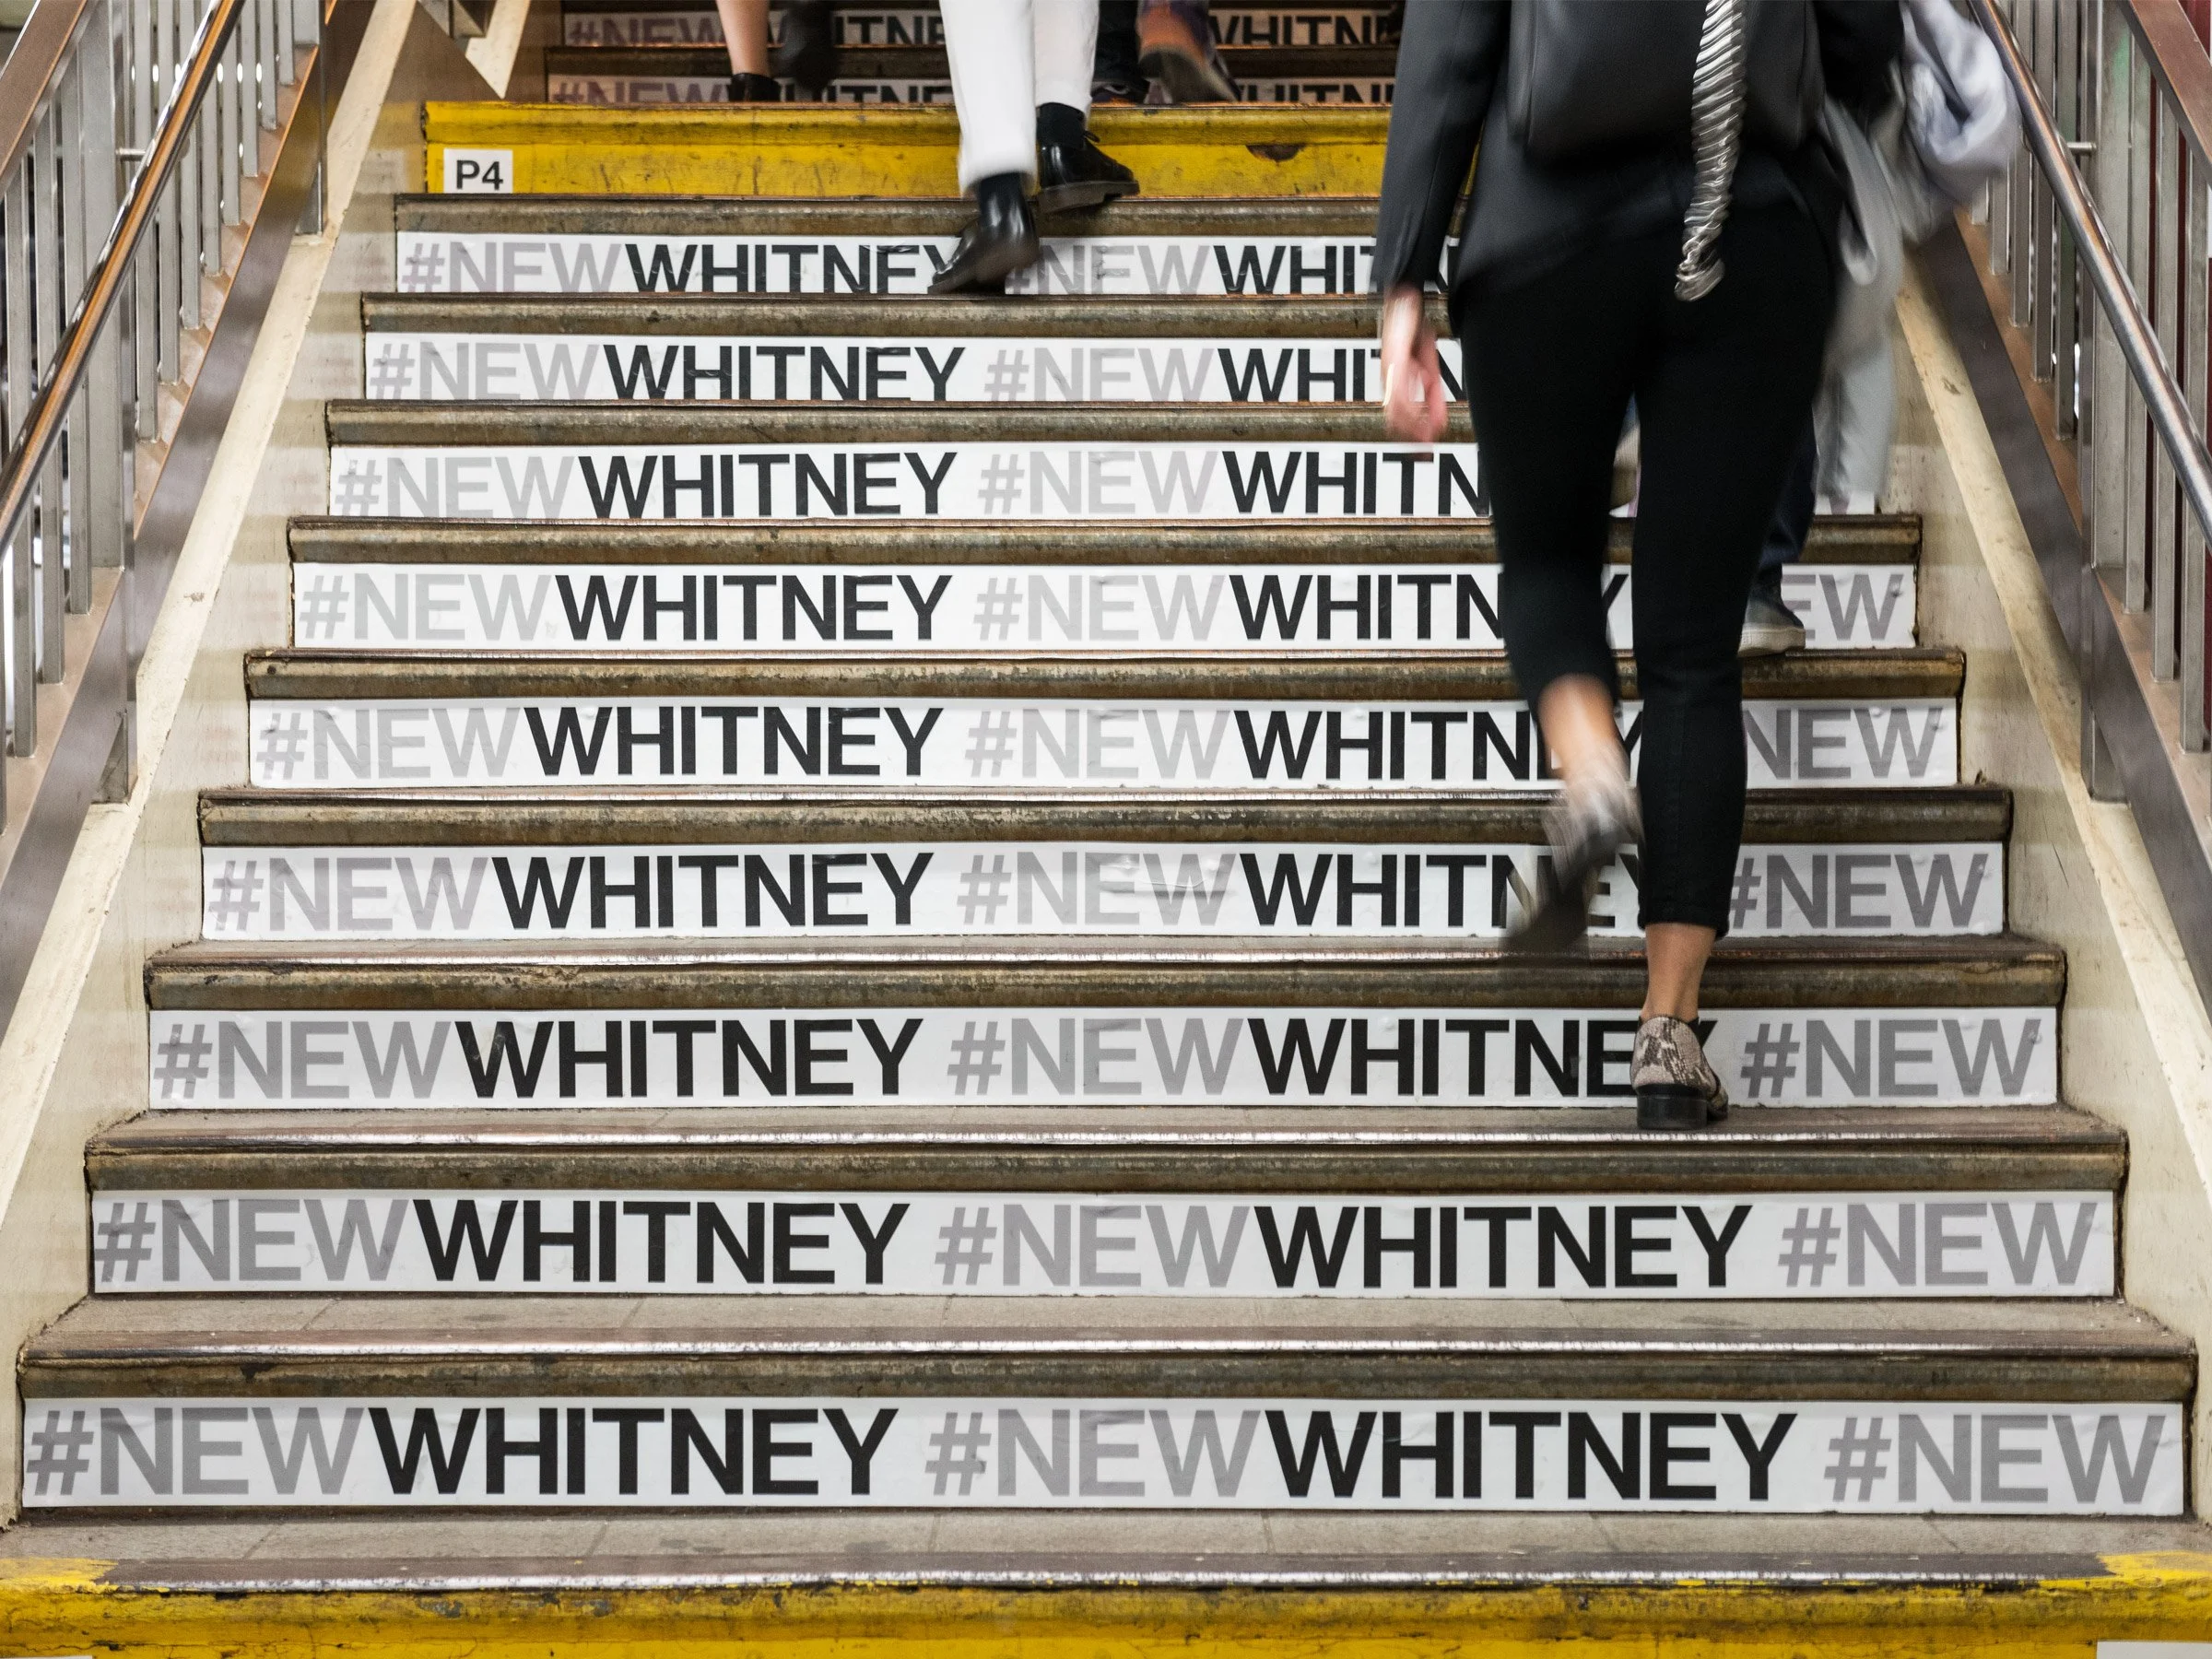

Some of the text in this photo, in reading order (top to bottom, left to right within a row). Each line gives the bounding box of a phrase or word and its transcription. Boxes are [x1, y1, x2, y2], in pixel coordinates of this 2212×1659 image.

[456, 159, 504, 190] P4
[1743, 708, 1944, 781] NEW
[1729, 853, 1989, 929] #NEW
[1740, 1018, 2041, 1099] #NEW
[1777, 1202, 2099, 1288] #NEW
[1823, 1413, 2166, 1504] #NEW
